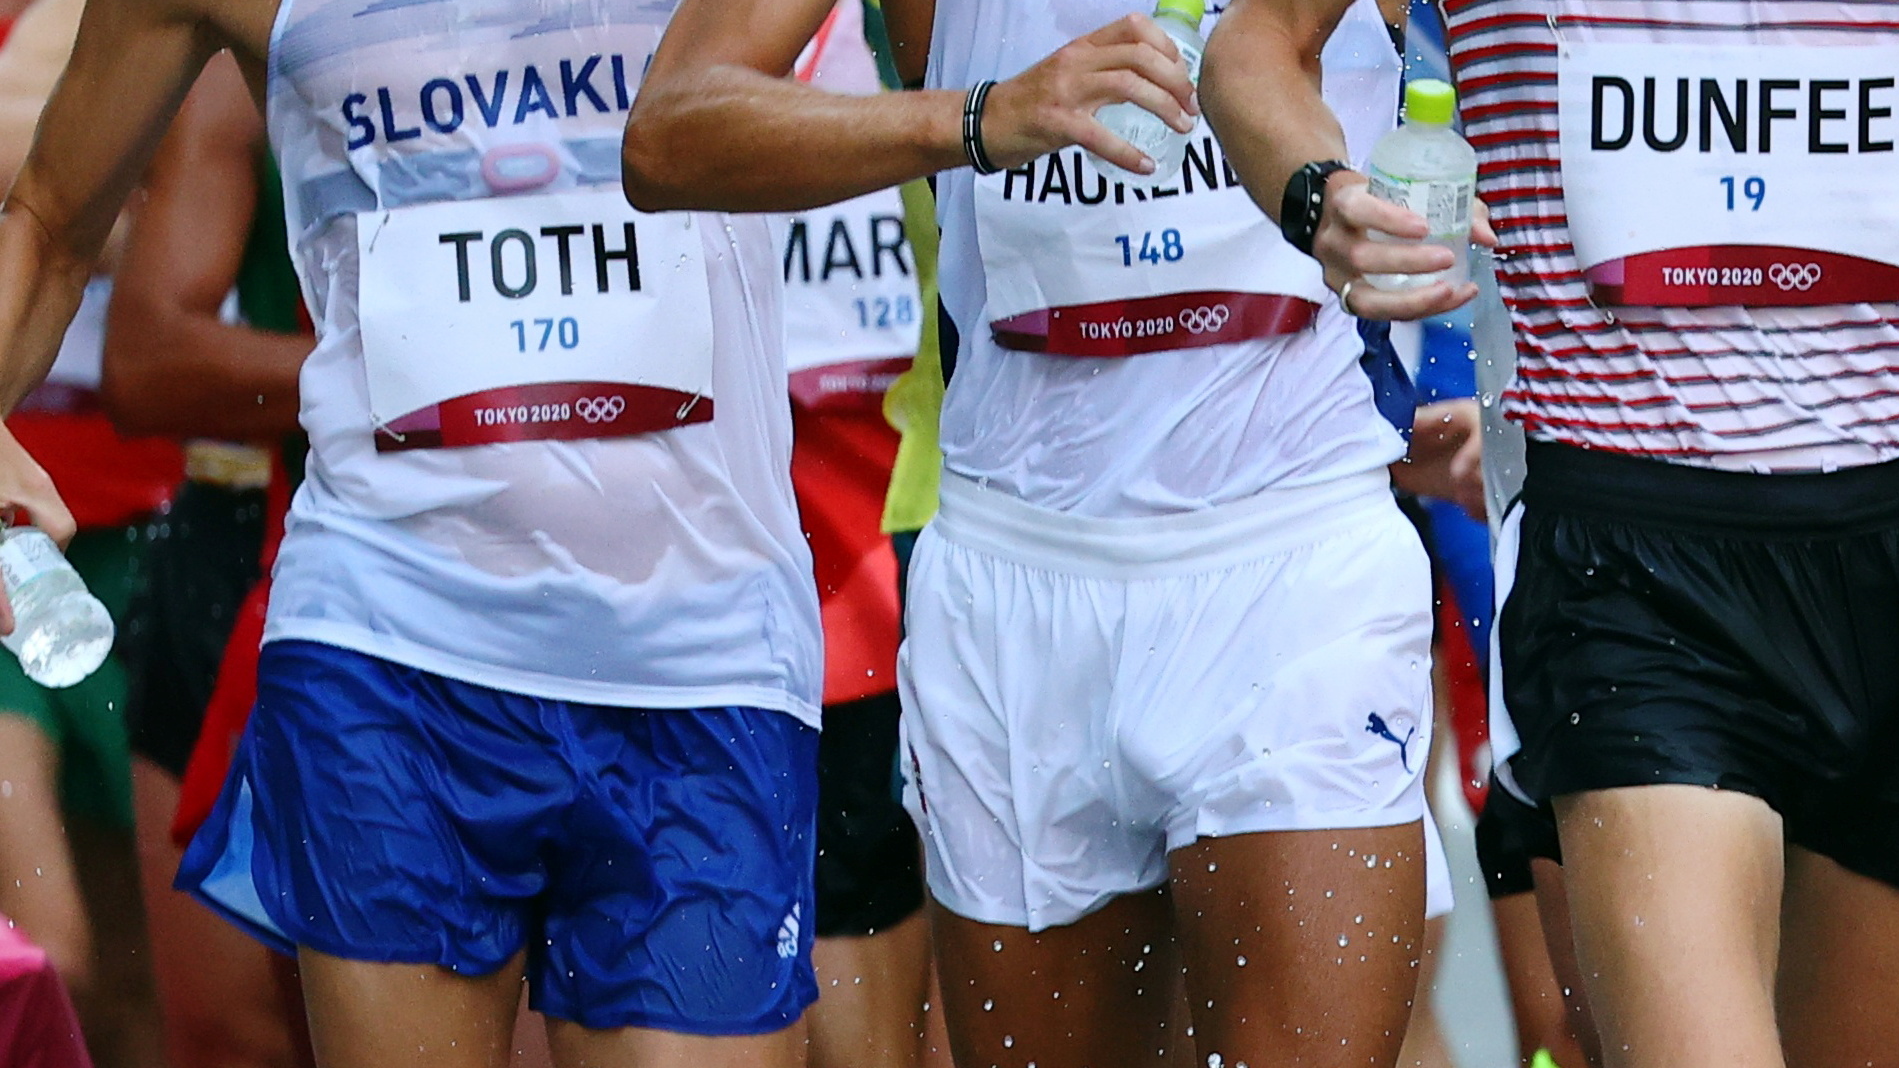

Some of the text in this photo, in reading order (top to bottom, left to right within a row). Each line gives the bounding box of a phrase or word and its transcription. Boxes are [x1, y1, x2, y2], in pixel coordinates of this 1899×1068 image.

[342, 53, 653, 151] SLOVAKI
[1591, 75, 1895, 154] DUNFEE
[1720, 176, 1766, 212] 19
[439, 221, 641, 303] TOTH
[1115, 228, 1184, 267] 148
[1662, 266, 1763, 286] TOKYO 2020
[510, 316, 579, 353] 170
[1079, 316, 1174, 339] TOKYO 2020
[474, 402, 570, 426] TOKYO 2020
